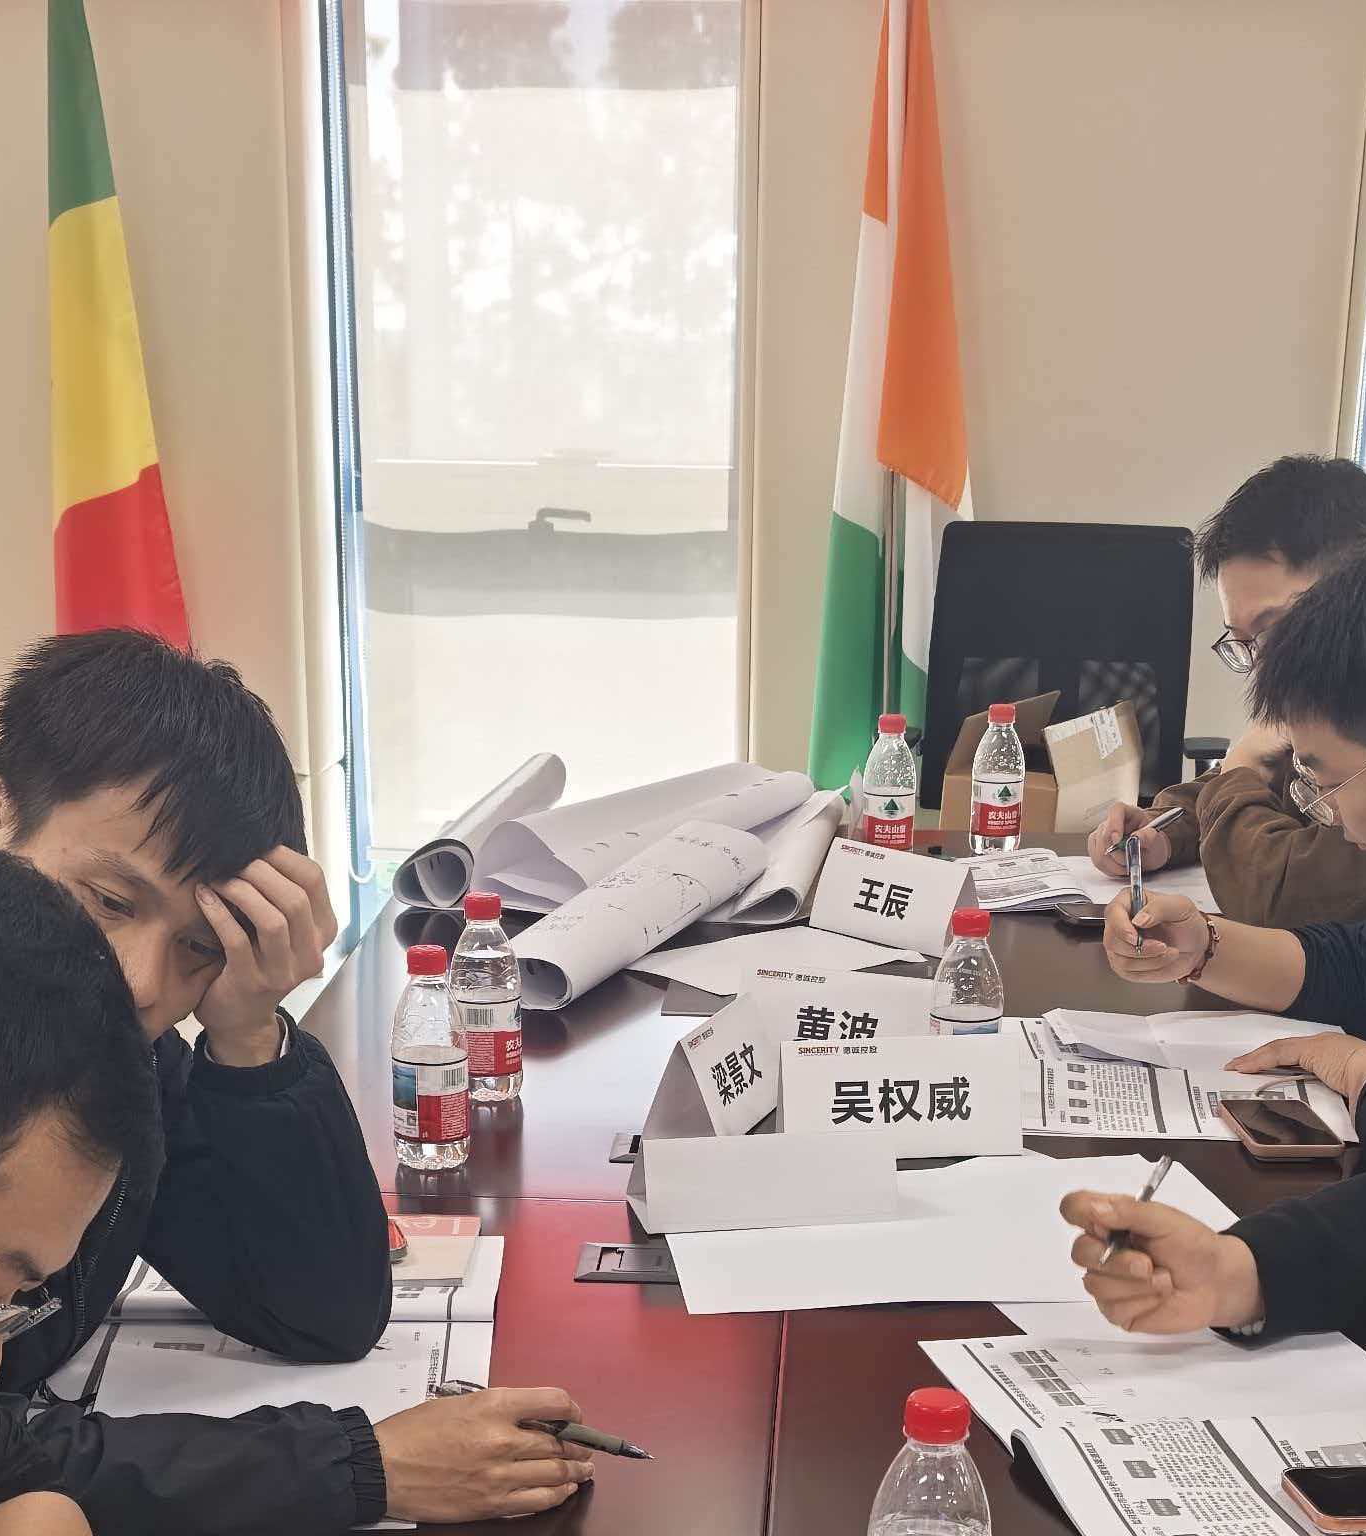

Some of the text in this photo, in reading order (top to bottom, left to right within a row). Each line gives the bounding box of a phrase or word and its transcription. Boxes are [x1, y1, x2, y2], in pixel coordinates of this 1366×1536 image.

[853, 877, 914, 920] 王辰
[756, 968, 794, 980] SINCERITY
[796, 1005, 879, 1041] 黄波
[798, 1046, 840, 1055] SINCERITY
[710, 1042, 763, 1107] 梁景文
[830, 1076, 972, 1125] 吴权威
